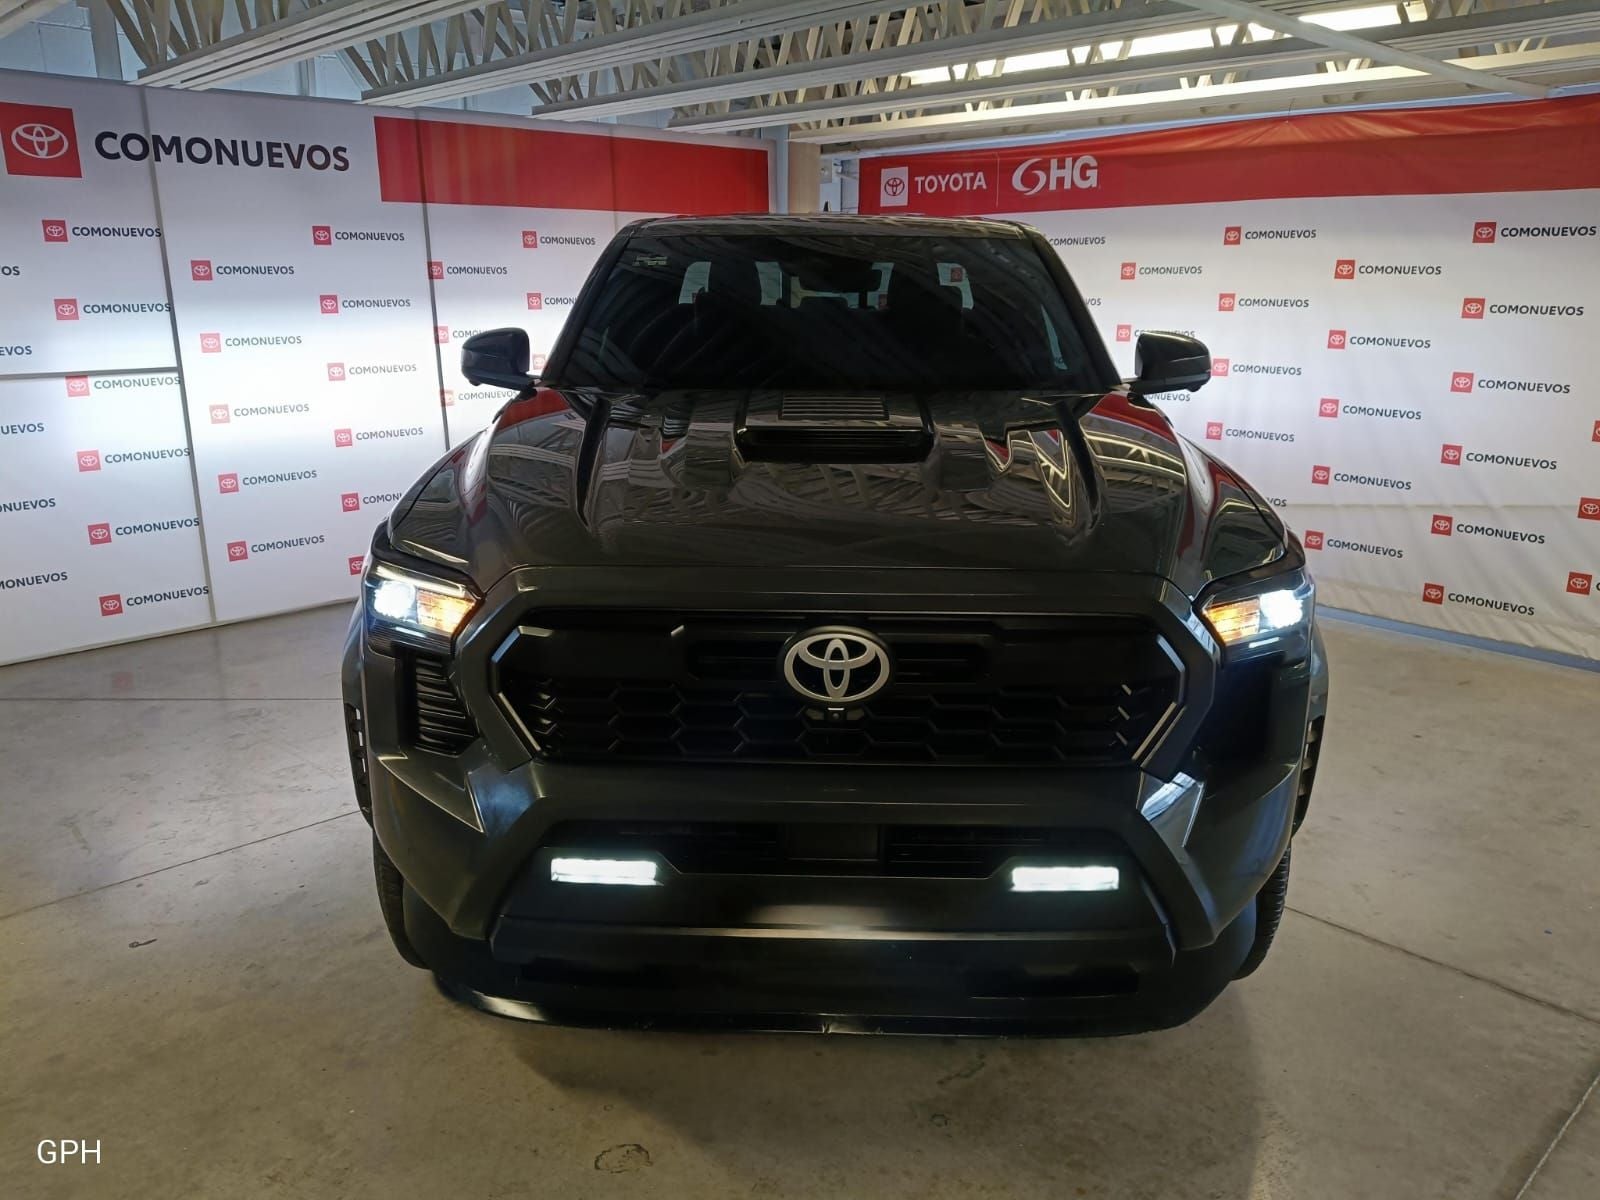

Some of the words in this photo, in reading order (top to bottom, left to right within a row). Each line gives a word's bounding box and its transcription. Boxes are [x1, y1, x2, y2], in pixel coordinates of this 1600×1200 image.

[95, 131, 350, 171] COMONUEVOS
[915, 171, 987, 194] TOYOTA
[72, 226, 162, 238] COMONUEVOS
[335, 230, 405, 242] COMONUEVOS
[1245, 229, 1317, 240] COMONUEVOS
[1501, 226, 1597, 238] COMONUEVOS
[540, 236, 596, 245] COMONUEVOS
[216, 265, 295, 275] COMONUEVOS
[1139, 266, 1202, 275] COMONUEVOS
[1358, 265, 1442, 276] COMONUEVOS
[83, 303, 171, 314] COMONUEVOS
[342, 298, 411, 309] COMONUEVOS
[1238, 298, 1309, 308] COMONUEVOS
[1489, 304, 1584, 316] COMONUEVOS
[225, 336, 302, 347] COMONUEVOS
[1350, 336, 1431, 348] COMONUEVOS
[349, 364, 417, 374] COMONUEVOS
[1232, 363, 1302, 375] COMONUEVOS
[94, 376, 180, 389] COMONUEVOS
[1478, 379, 1571, 394] COMONUEVOS
[234, 403, 309, 416] COMONUEVOS
[1343, 405, 1422, 420] COMONUEVOS
[356, 427, 424, 440] COMONUEVOS
[1225, 428, 1295, 442] COMONUEVOS
[105, 448, 190, 464] COMONUEVOS
[1466, 452, 1557, 470] COMONUEVOS
[243, 470, 317, 486] COMONUEVOS
[1334, 473, 1412, 490] COMONUEVOS
[115, 518, 199, 536] COMONUEVOS
[1457, 523, 1546, 544] COMONUEVOS
[251, 535, 325, 553] COMONUEVOS
[1327, 538, 1404, 558] COMONUEVOS
[126, 586, 209, 606] COMONUEVOS
[1448, 592, 1535, 616] COMONUEVOS
